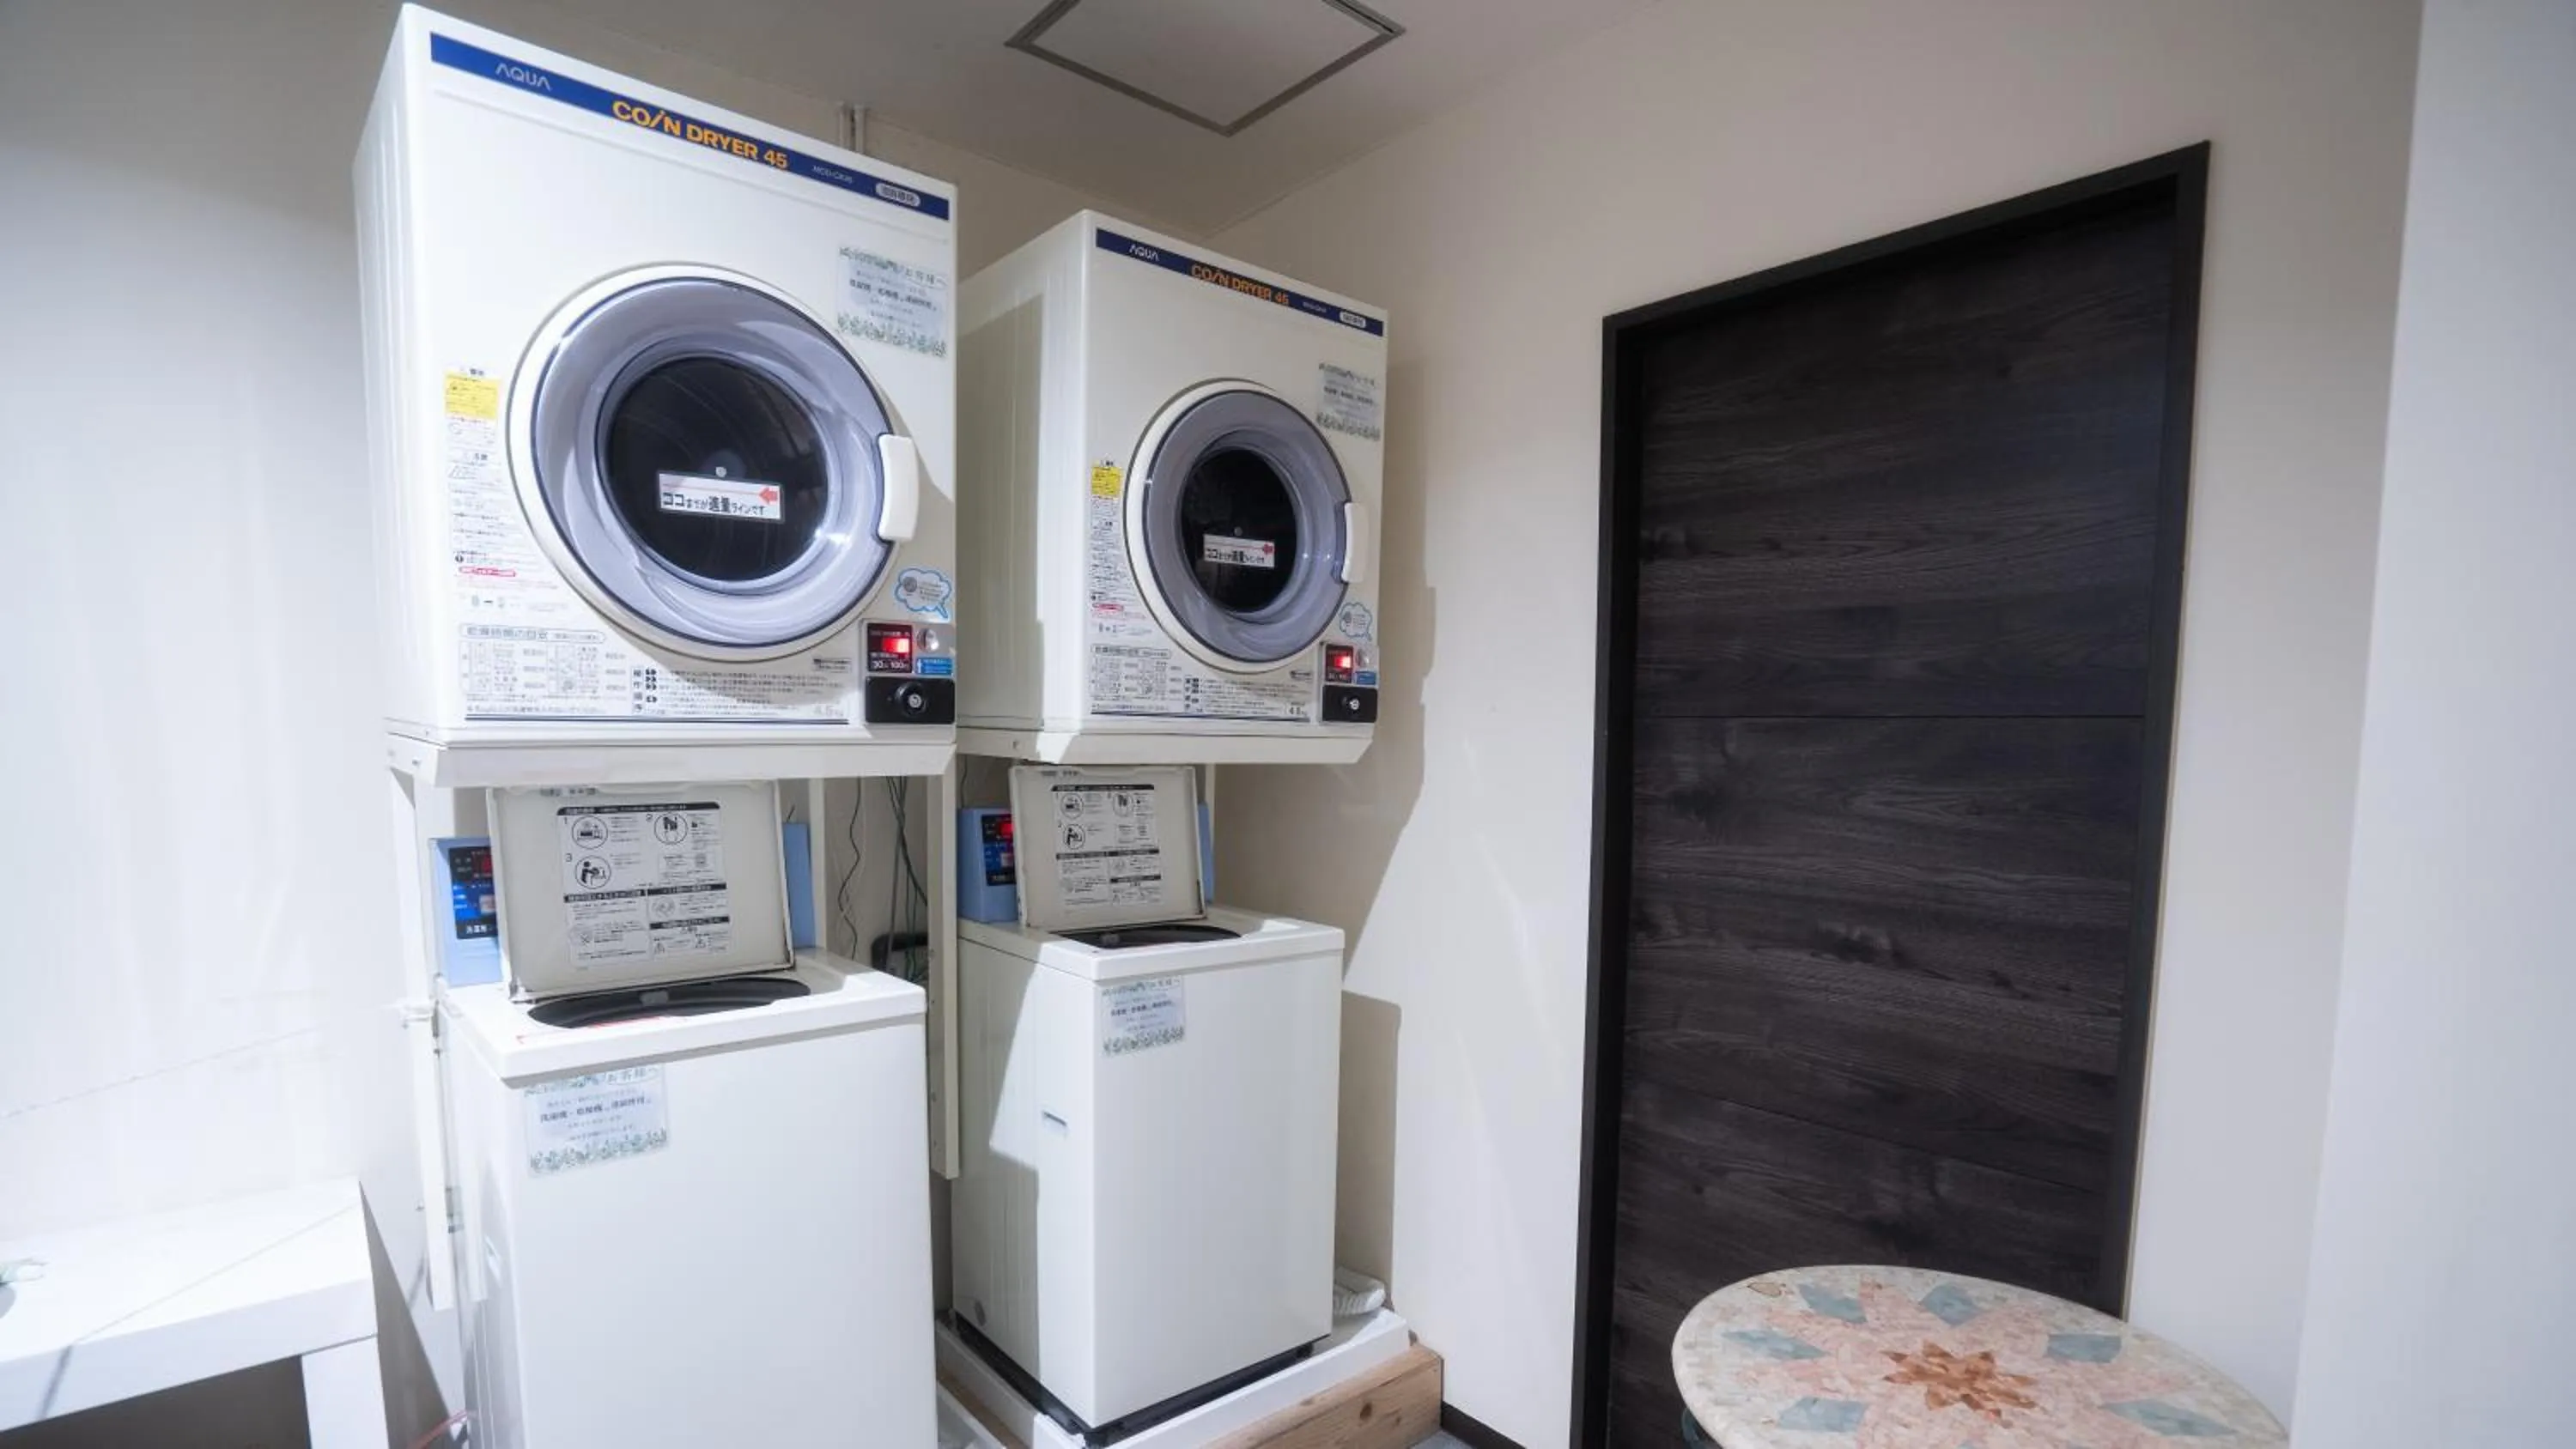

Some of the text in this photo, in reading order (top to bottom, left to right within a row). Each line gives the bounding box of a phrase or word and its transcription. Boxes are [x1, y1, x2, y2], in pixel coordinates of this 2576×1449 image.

[495, 63, 550, 91] AQUA
[686, 123, 759, 161] DRYER
[764, 149, 788, 170] 45
[1129, 244, 1160, 261] AQUA
[1232, 277, 1273, 301] DRYER
[1274, 291, 1290, 306] 45
